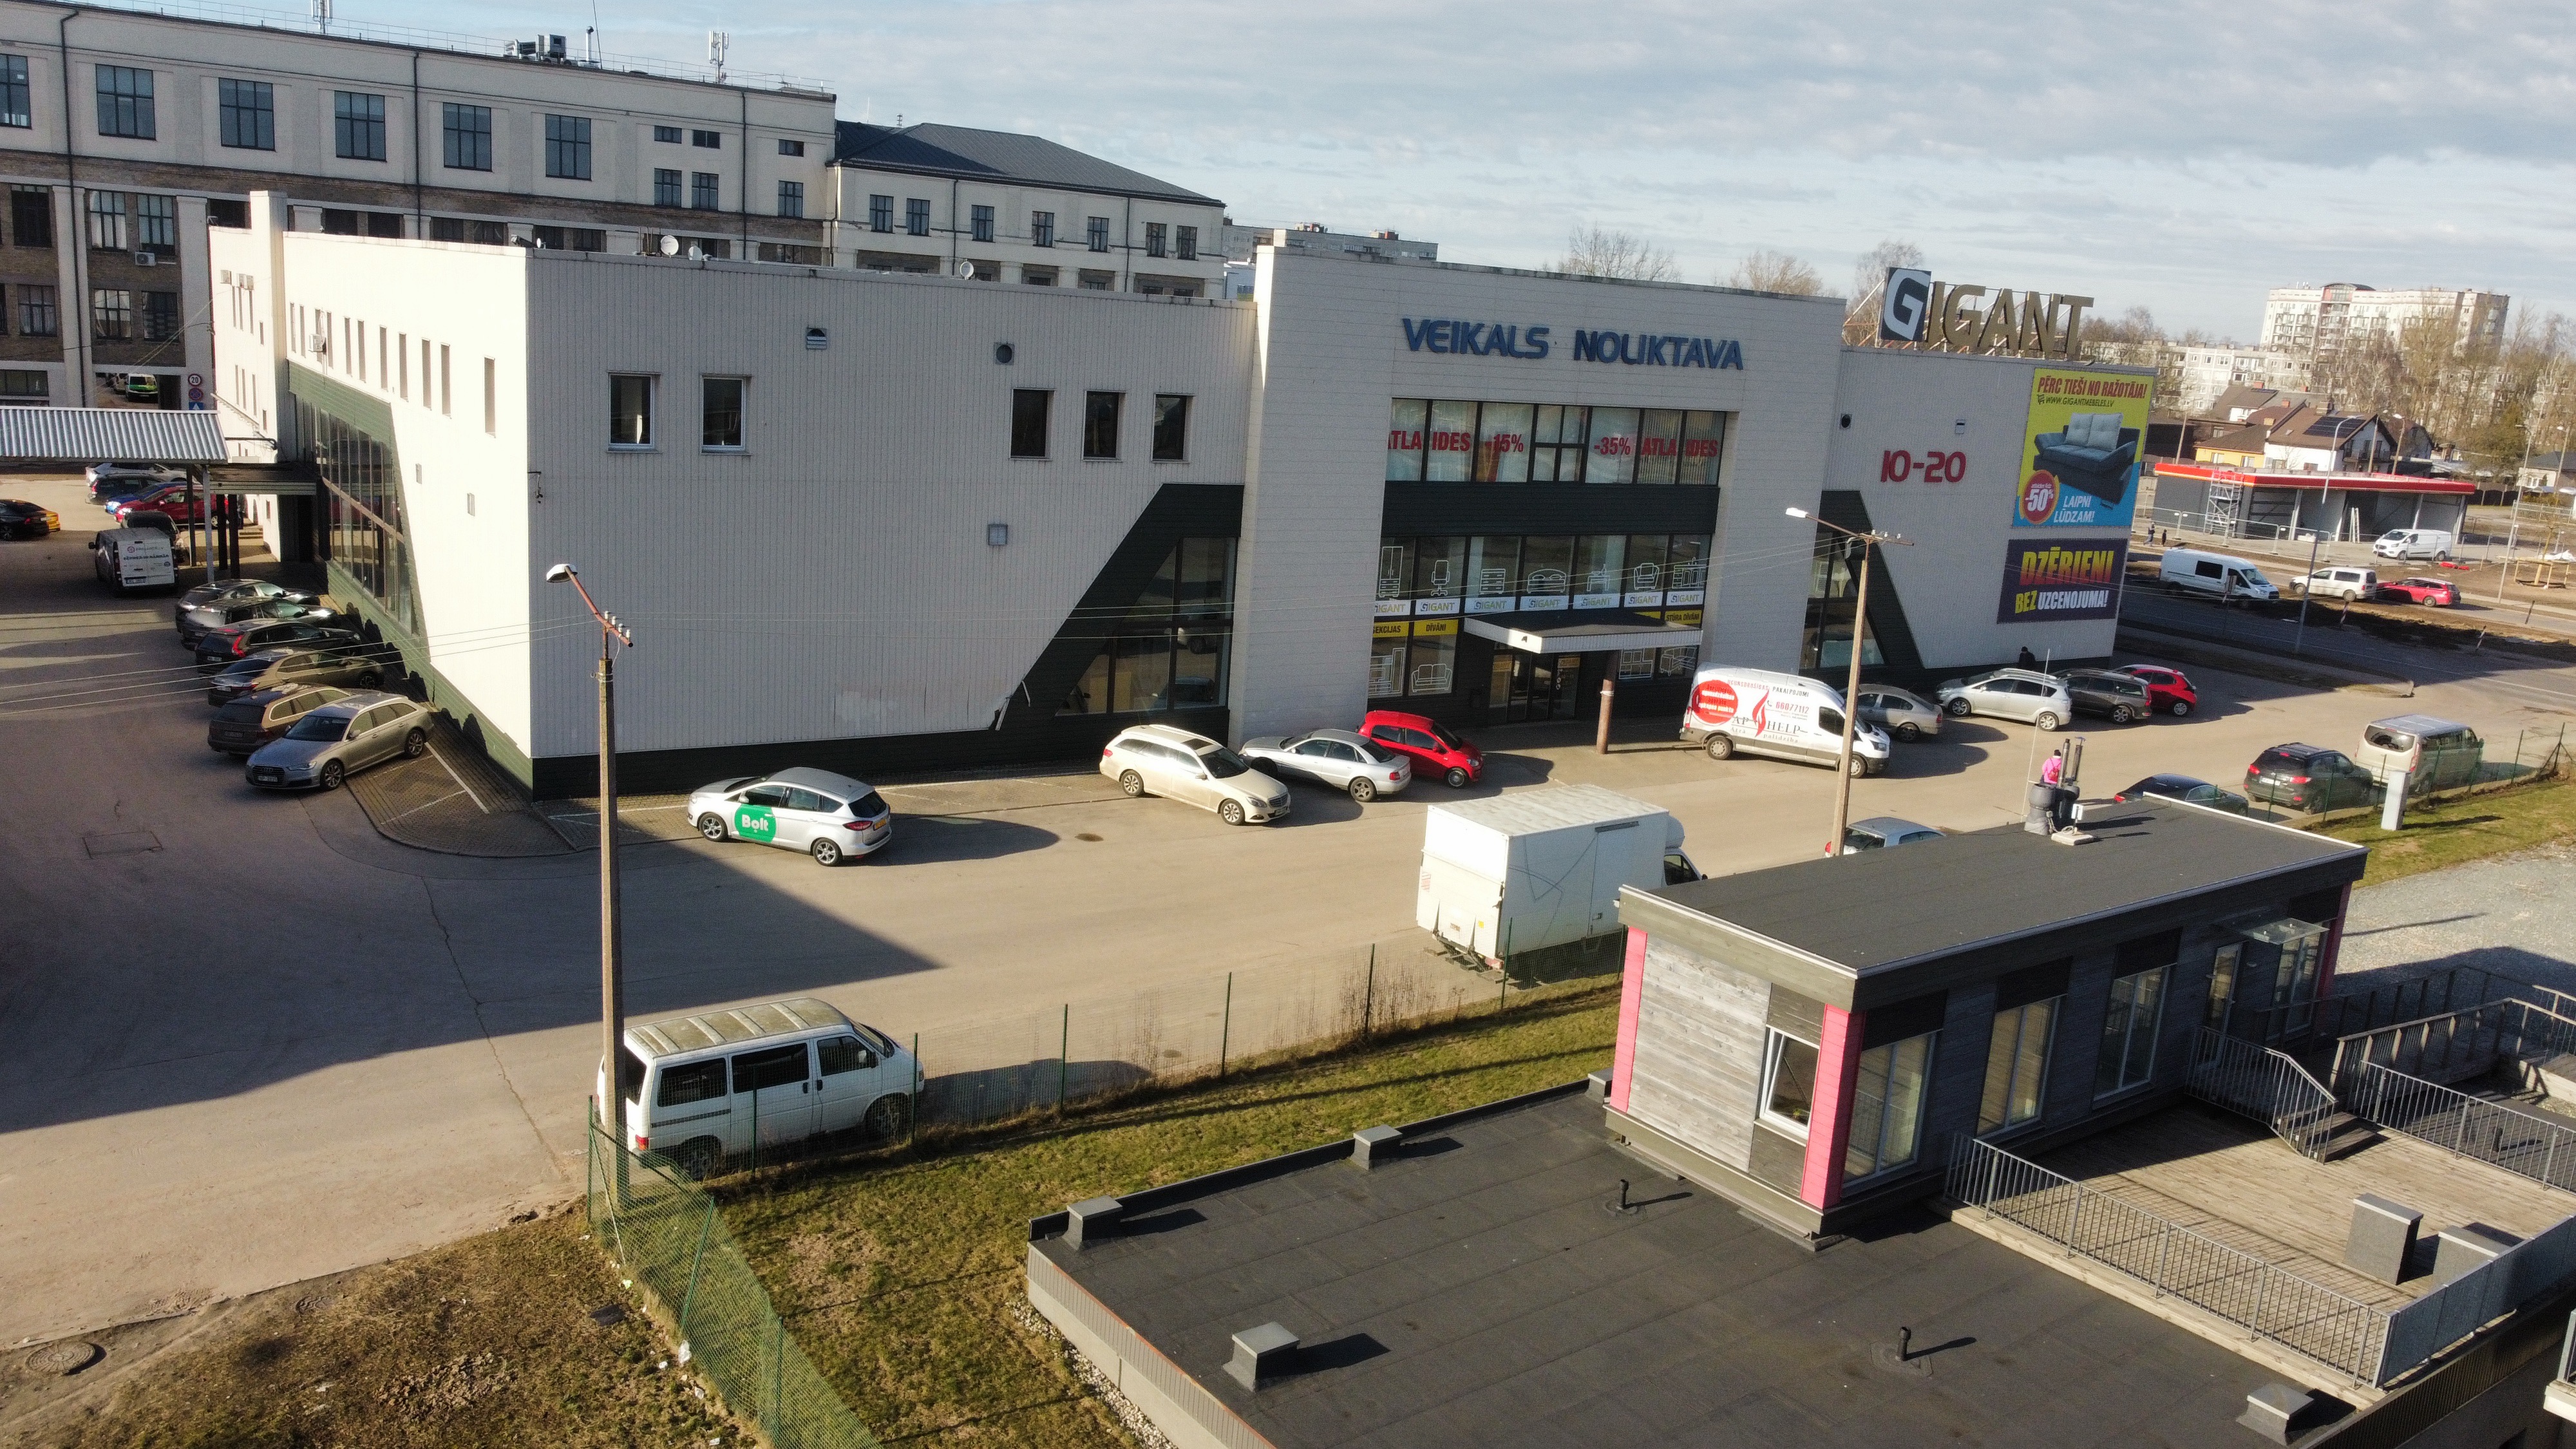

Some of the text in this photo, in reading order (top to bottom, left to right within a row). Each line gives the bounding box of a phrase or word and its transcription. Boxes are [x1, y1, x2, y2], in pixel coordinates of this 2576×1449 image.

[1880, 267, 2094, 354] GIGANT
[1403, 319, 1743, 370] VEIKALS NOLIKTAVA
[2037, 375, 2148, 399] PĒRC TIEŠI NO RAŽOTĀJA!
[2046, 395, 2114, 407] WWW.GIGANTMEBELES.LV
[1484, 434, 1524, 453] -15%
[1594, 437, 1631, 455] -35%
[1880, 450, 1966, 482] 10-20
[2063, 495, 2092, 507] LAIPNI
[2054, 509, 2095, 523] LŪDZAM!
[2020, 546, 2114, 586] DZĒRIENI
[2015, 590, 2109, 614] BEZ UZCENOJUMA!
[1732, 715, 1801, 734] AP HELP
[742, 814, 769, 833] Bolt
